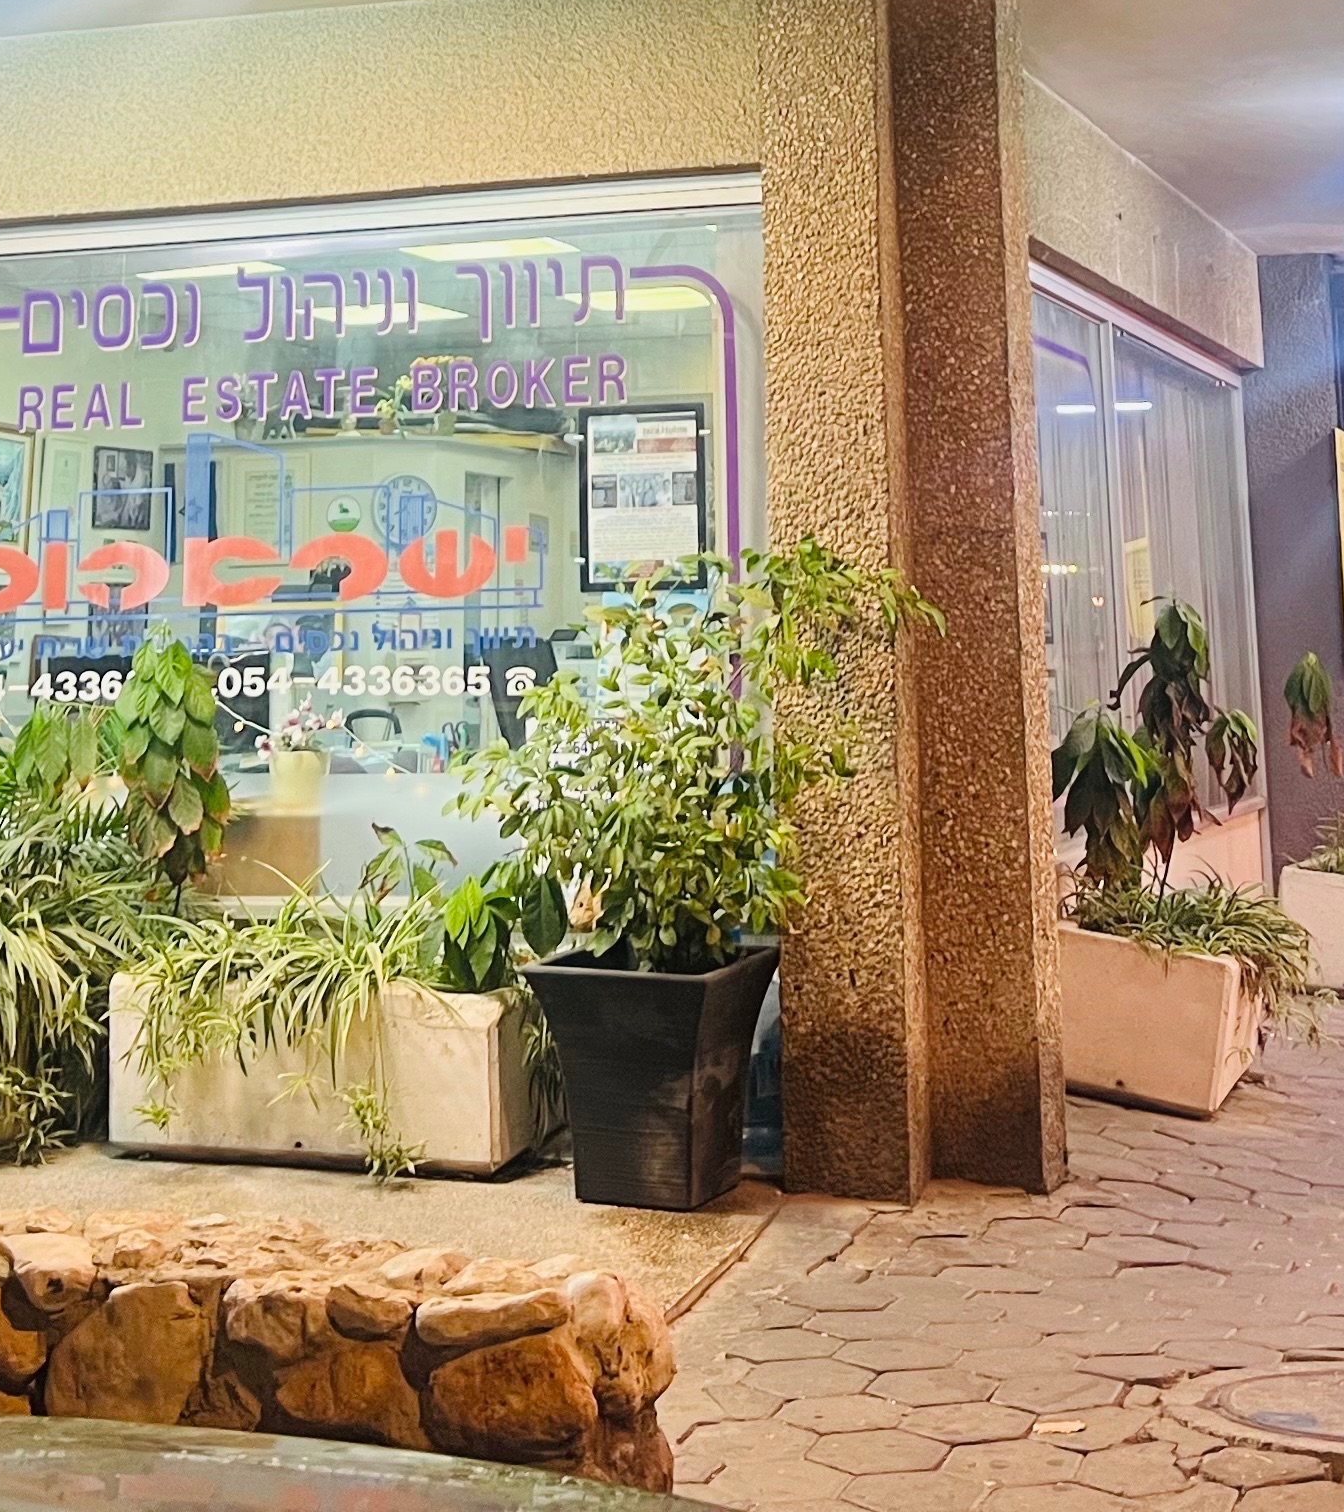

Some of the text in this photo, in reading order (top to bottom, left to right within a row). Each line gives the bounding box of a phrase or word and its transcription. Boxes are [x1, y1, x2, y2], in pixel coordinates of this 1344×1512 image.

[20, 255, 628, 357] תיווך וניהול נכסים
[17, 382, 146, 433] REAL
[181, 366, 380, 426] ESTATE
[411, 353, 629, 415] BROKER
